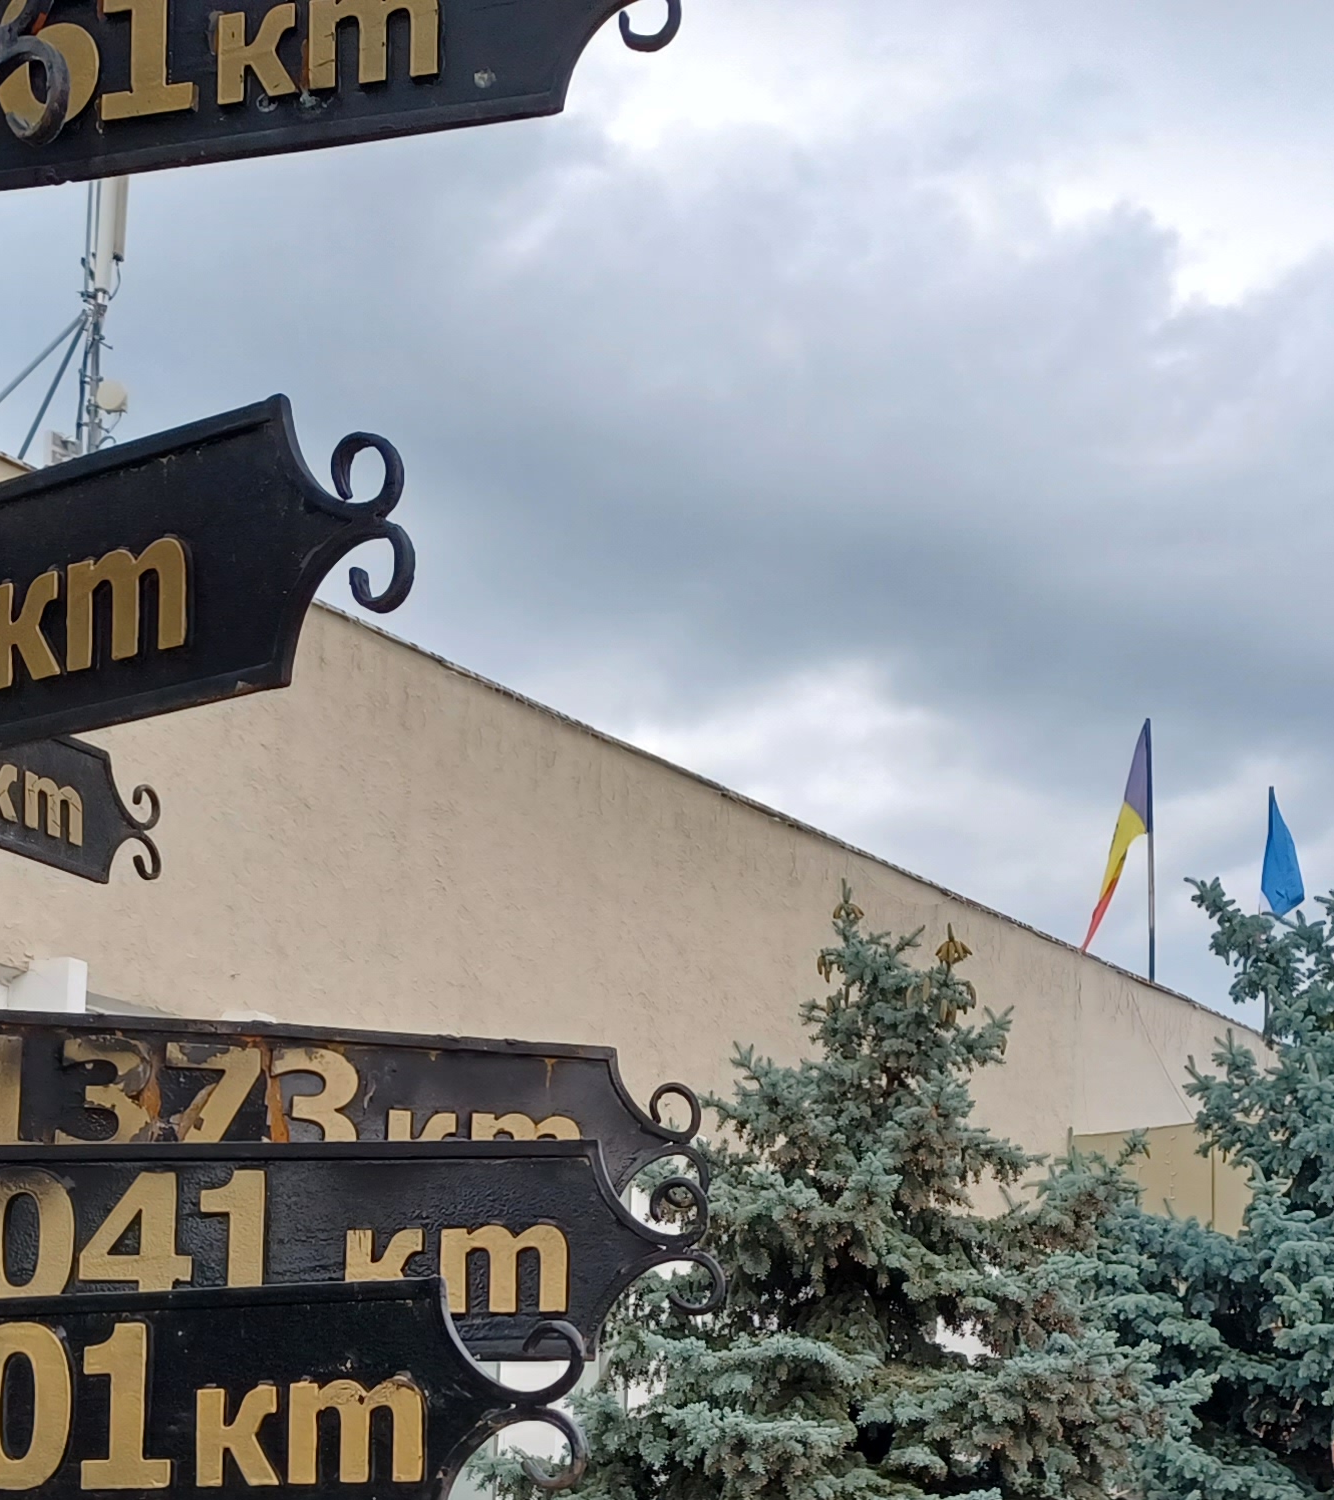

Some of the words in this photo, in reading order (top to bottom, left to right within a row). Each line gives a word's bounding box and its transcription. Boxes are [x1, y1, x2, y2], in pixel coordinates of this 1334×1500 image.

[217, 0, 440, 105] km
[345, 1224, 568, 1314] km
[195, 1375, 427, 1488] km
